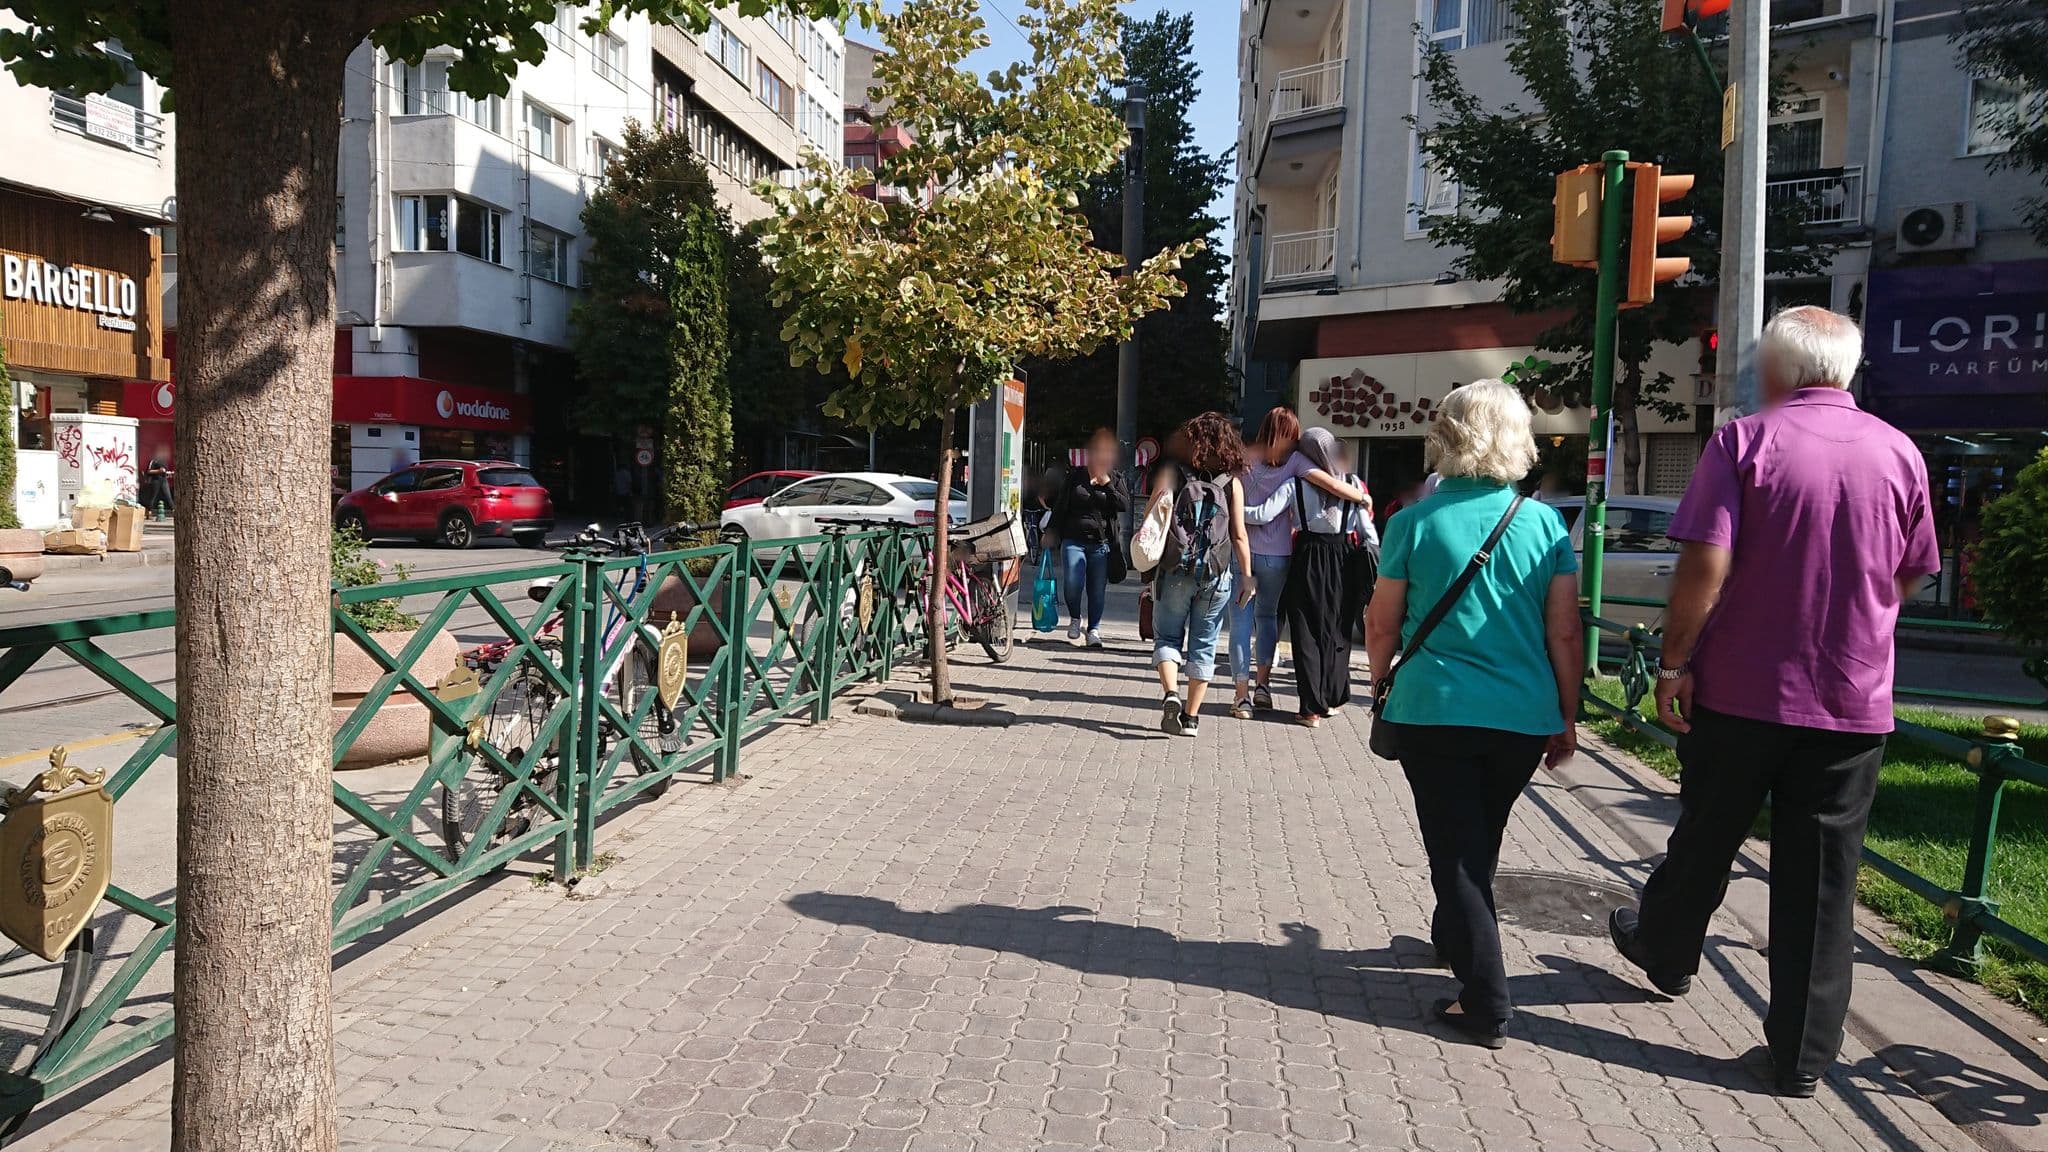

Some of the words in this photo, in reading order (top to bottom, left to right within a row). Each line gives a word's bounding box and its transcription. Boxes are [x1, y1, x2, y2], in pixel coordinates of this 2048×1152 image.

[4, 254, 136, 316] BARGELLO
[100, 316, 135, 330] Perfume
[456, 401, 510, 420] vodafone
[1380, 421, 1406, 432] 1958
